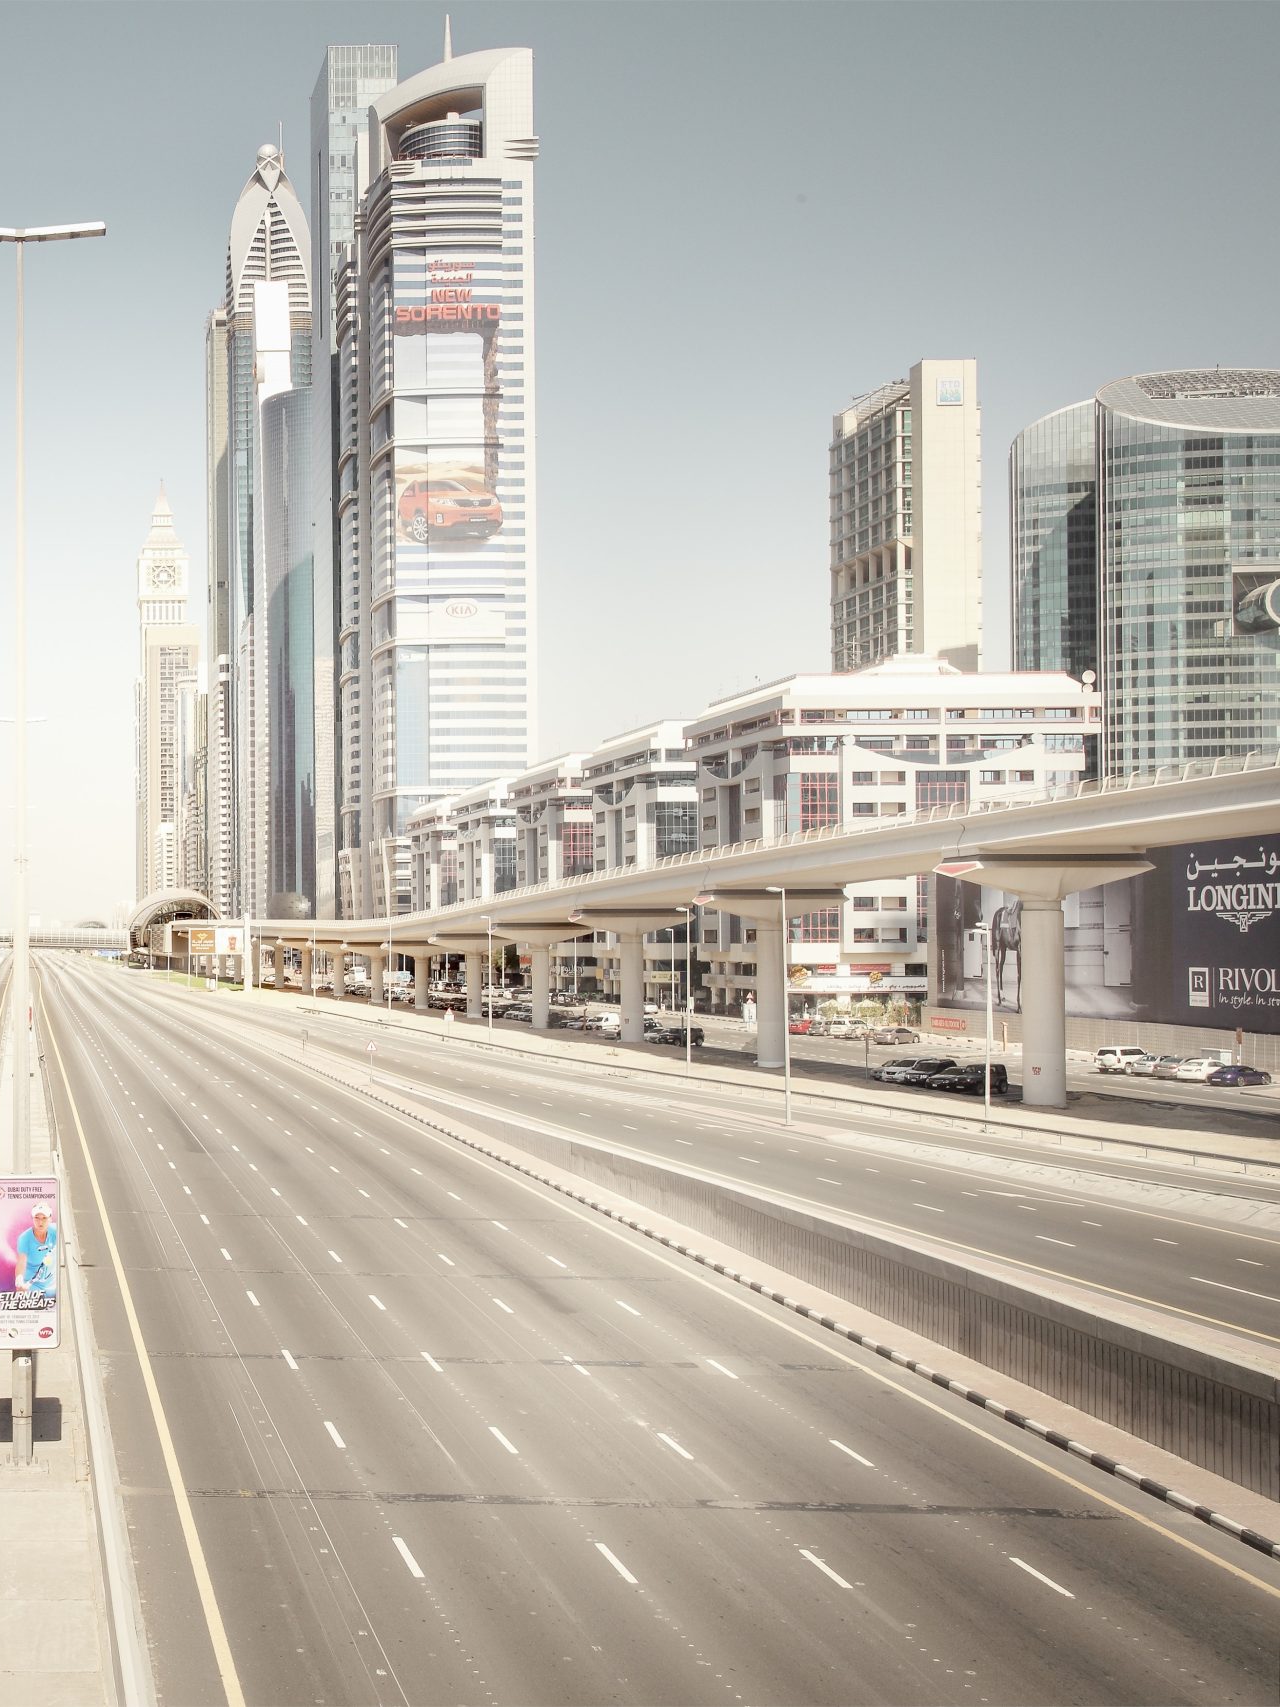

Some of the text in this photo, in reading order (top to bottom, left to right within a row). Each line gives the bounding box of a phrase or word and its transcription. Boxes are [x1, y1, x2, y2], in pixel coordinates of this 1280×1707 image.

[431, 288, 472, 303] NEW
[395, 305, 500, 321] SORENTO
[1186, 846, 1280, 881] ونجين
[1194, 975, 1204, 989] R
[31, 1290, 45, 1299] OF
[0, 1297, 56, 1310] THE GREATS
